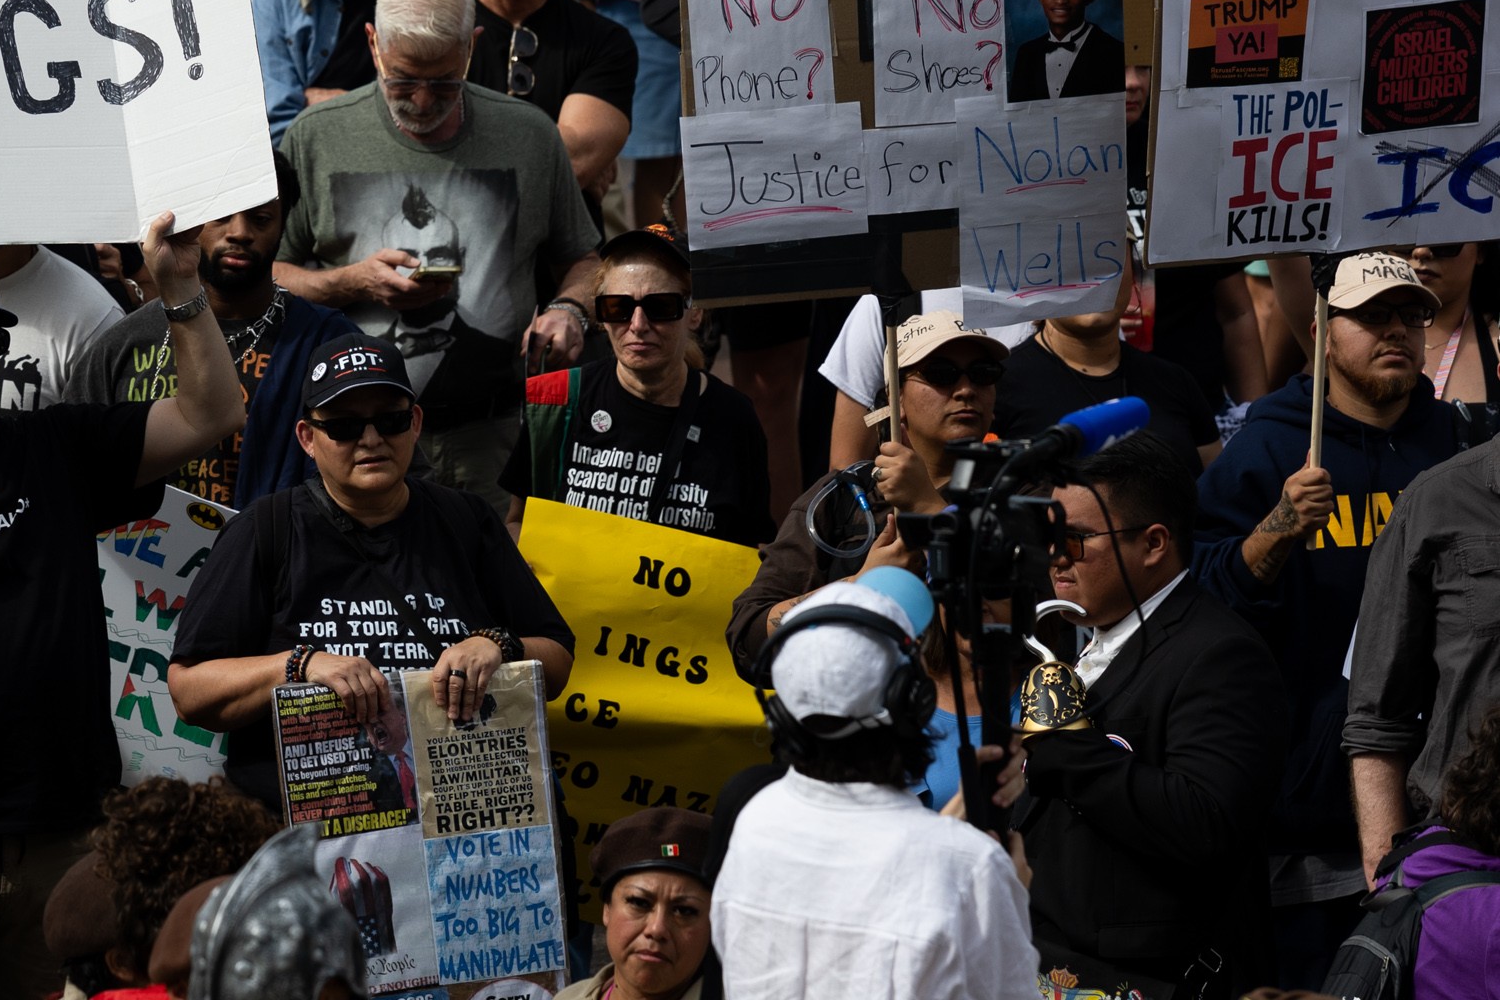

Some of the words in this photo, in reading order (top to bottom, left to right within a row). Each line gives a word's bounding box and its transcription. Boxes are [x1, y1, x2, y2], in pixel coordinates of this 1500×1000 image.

[1227, 31, 1266, 56] YA!
[1393, 27, 1456, 57] ISRAEL
[695, 46, 825, 107] Phone?
[883, 40, 1002, 95] Shoes?
[1378, 49, 1469, 83] MURDERS
[1377, 72, 1468, 105] CHILDREN
[1232, 93, 1276, 137] THE
[1283, 88, 1344, 131] POL-
[690, 140, 865, 216] Justice
[878, 141, 956, 197] for
[974, 116, 1123, 194] Nolan
[1228, 129, 1338, 209] ICE
[1226, 202, 1332, 247] KILLS!
[972, 221, 1124, 293] Wells
[338, 352, 378, 371] FDT
[571, 441, 633, 471] Imagine
[566, 467, 619, 492] scared
[619, 474, 638, 495] of
[586, 494, 615, 514] not
[632, 555, 692, 598] NO
[299, 620, 338, 638] FOR
[347, 620, 398, 637] YOUR
[324, 642, 369, 659] NOT
[594, 625, 709, 685] INGS
[278, 698, 292, 708] I've
[293, 697, 313, 706] never
[314, 692, 336, 703] heard
[290, 687, 305, 698] long
[315, 686, 328, 694] I've
[279, 706, 302, 717] sitting
[303, 700, 337, 714] president
[426, 736, 443, 745] YOU
[444, 735, 460, 743] ALL
[461, 731, 494, 741] REALIZE
[495, 728, 516, 737] THAT
[427, 742, 472, 760] ELON
[476, 735, 527, 754] TRIES
[284, 744, 307, 759] AND
[308, 743, 313, 755] I
[315, 737, 355, 754] REFUSE
[285, 759, 298, 770] TO
[300, 755, 318, 769] GET
[320, 751, 348, 766] USED
[349, 750, 360, 761] TO
[361, 748, 373, 760] IT.
[430, 760, 442, 768] TO
[444, 757, 461, 766] RIG
[462, 755, 482, 764] THE
[483, 749, 529, 762] ELECTION
[287, 771, 300, 782] It's
[300, 767, 328, 781] beyond
[329, 766, 341, 775] the
[342, 762, 372, 775] cursing.
[431, 767, 445, 775] AND
[446, 764, 476, 773] HEGSETH
[501, 757, 529, 766] MARTIAL
[431, 764, 530, 786] LAW/MILITARY
[289, 782, 306, 792] That
[307, 779, 334, 791] anyone
[335, 773, 367, 785] watches
[290, 792, 305, 801] this
[305, 788, 320, 799] and
[321, 787, 337, 796] sees
[338, 781, 377, 795] leadership
[434, 794, 447, 802] TO
[449, 791, 469, 801] FLIP
[470, 789, 490, 798] THE
[491, 783, 533, 795] FUCKING
[456, 782, 470, 791] IT'S
[471, 781, 483, 789] UP
[495, 778, 509, 786] ALL
[510, 776, 520, 784] OF
[291, 802, 300, 812] is
[301, 796, 347, 811] something
[352, 792, 368, 803] will
[292, 809, 323, 822] NEVER
[324, 803, 375, 817] understand.
[435, 799, 482, 814] TABLE.
[485, 792, 534, 808] RIGHT?
[332, 818, 342, 833] A
[436, 804, 535, 834] RIGHT??
[444, 832, 503, 864] VOTE
[508, 828, 530, 854] IN
[445, 863, 541, 904] NUMBERS
[435, 912, 479, 943] TOO
[485, 906, 520, 940] BIG
[525, 901, 555, 931] TO
[375, 953, 417, 976] People
[439, 938, 565, 982] MANIPULATE
[379, 974, 440, 993] ENOUGH!!!
